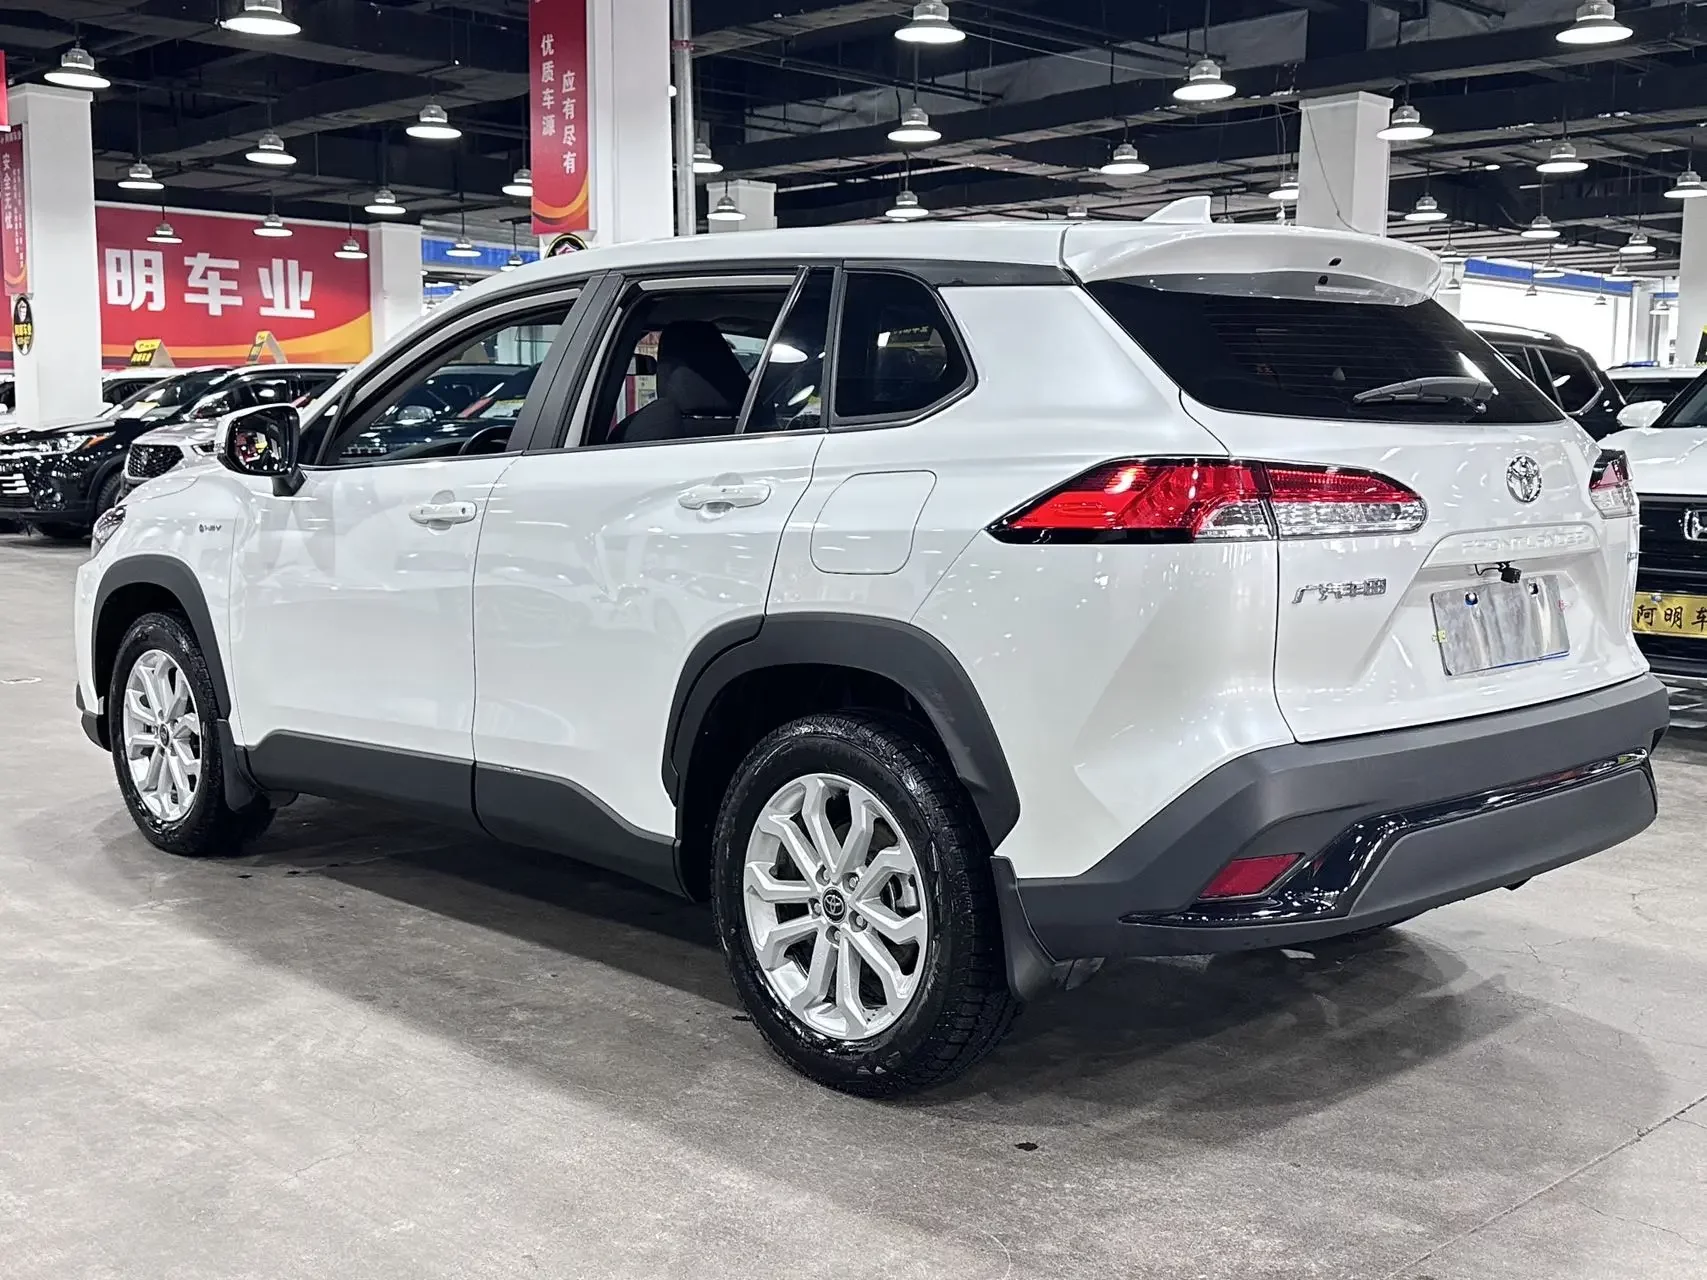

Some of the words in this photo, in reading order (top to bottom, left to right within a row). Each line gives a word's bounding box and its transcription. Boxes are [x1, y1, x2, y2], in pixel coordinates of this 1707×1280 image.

[540, 33, 556, 137] 优质车源
[561, 69, 577, 175] 应有尽有
[105, 247, 316, 319] 明车业
